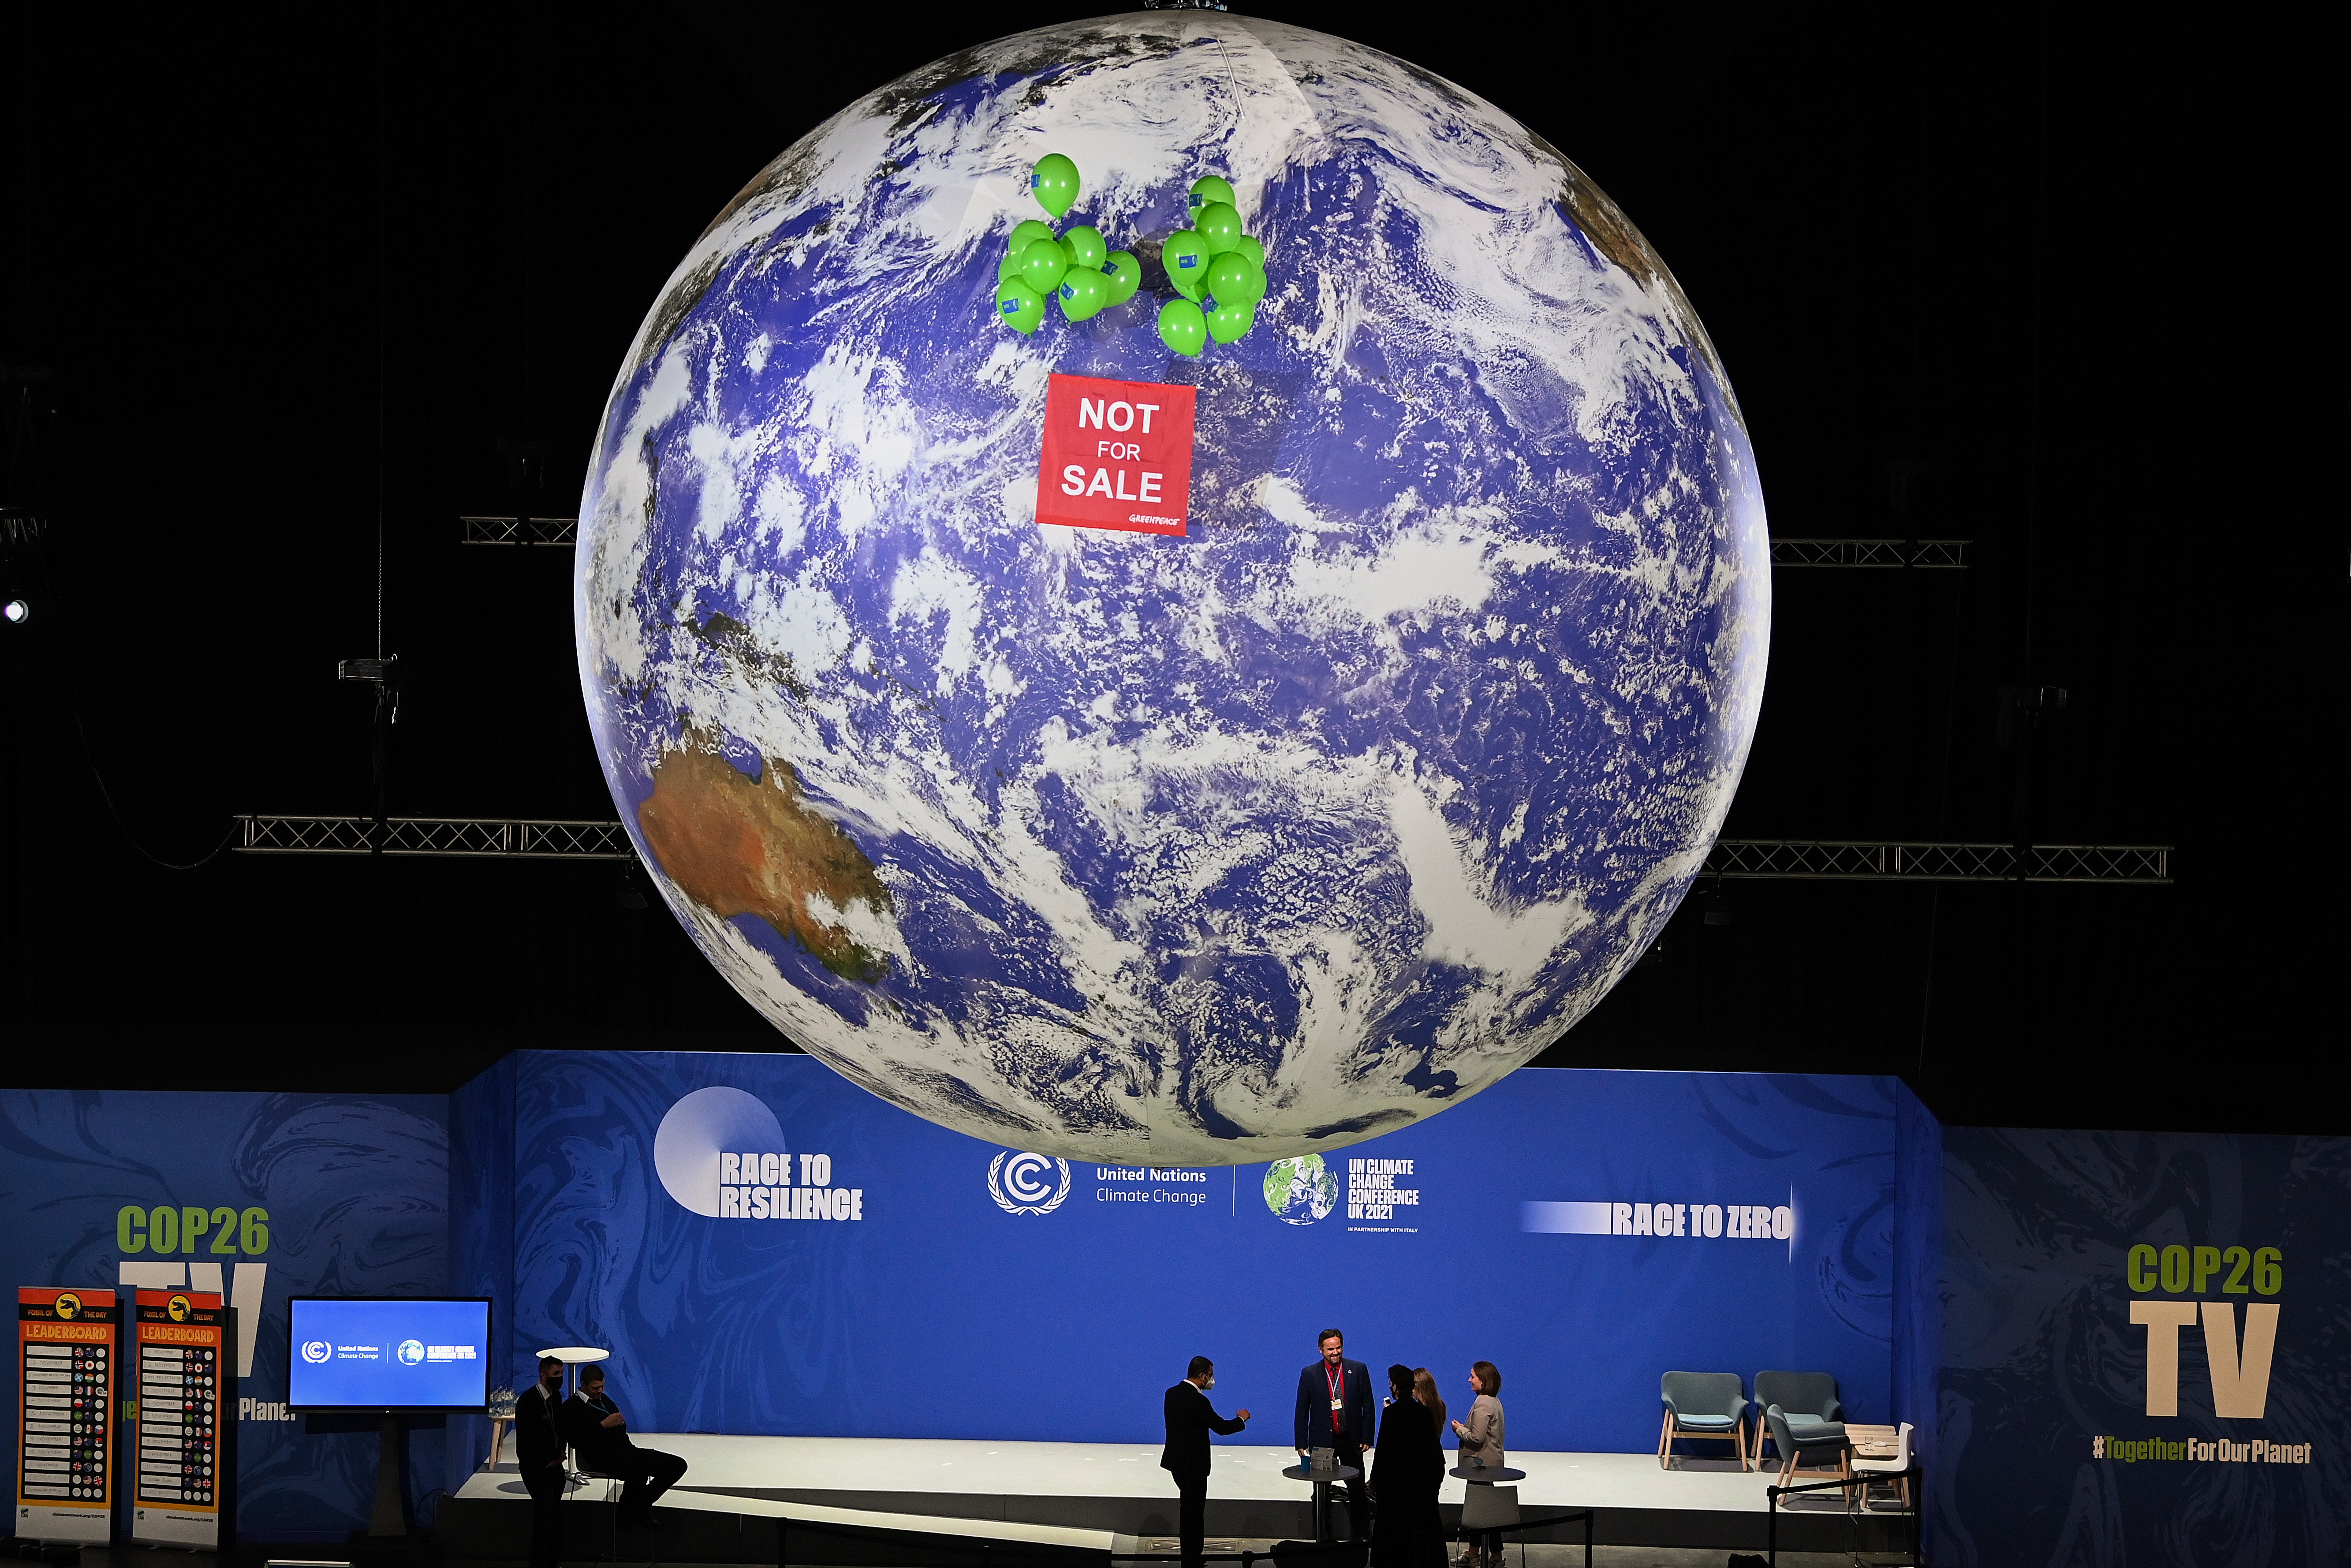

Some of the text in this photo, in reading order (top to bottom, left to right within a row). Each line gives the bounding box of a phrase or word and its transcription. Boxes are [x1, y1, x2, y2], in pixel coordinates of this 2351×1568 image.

[1079, 398, 1160, 433] NOT
[1097, 441, 1141, 461] FOR
[1061, 465, 1163, 503] SALE
[1129, 514, 1180, 526] GREENPEACE
[721, 1153, 831, 1187] RACE TO
[1097, 1167, 1206, 1182] United Nations
[1349, 1158, 1414, 1175] UN CLIMATE
[1348, 1174, 1394, 1189] CHANGE
[720, 1186, 863, 1221] RESILIENCE
[1097, 1187, 1206, 1206] Climate Change
[1348, 1189, 1419, 1205] CONFERENCE
[1348, 1204, 1393, 1219] UK 2021
[1612, 1202, 1791, 1239] RACE TO ZERO
[117, 1205, 269, 1255] COP26
[2127, 1244, 2283, 1295] COP26
[26, 1325, 107, 1340] LEADERBOARD
[142, 1327, 214, 1343] LEADERBOARD
[2130, 1300, 2280, 1419] TV
